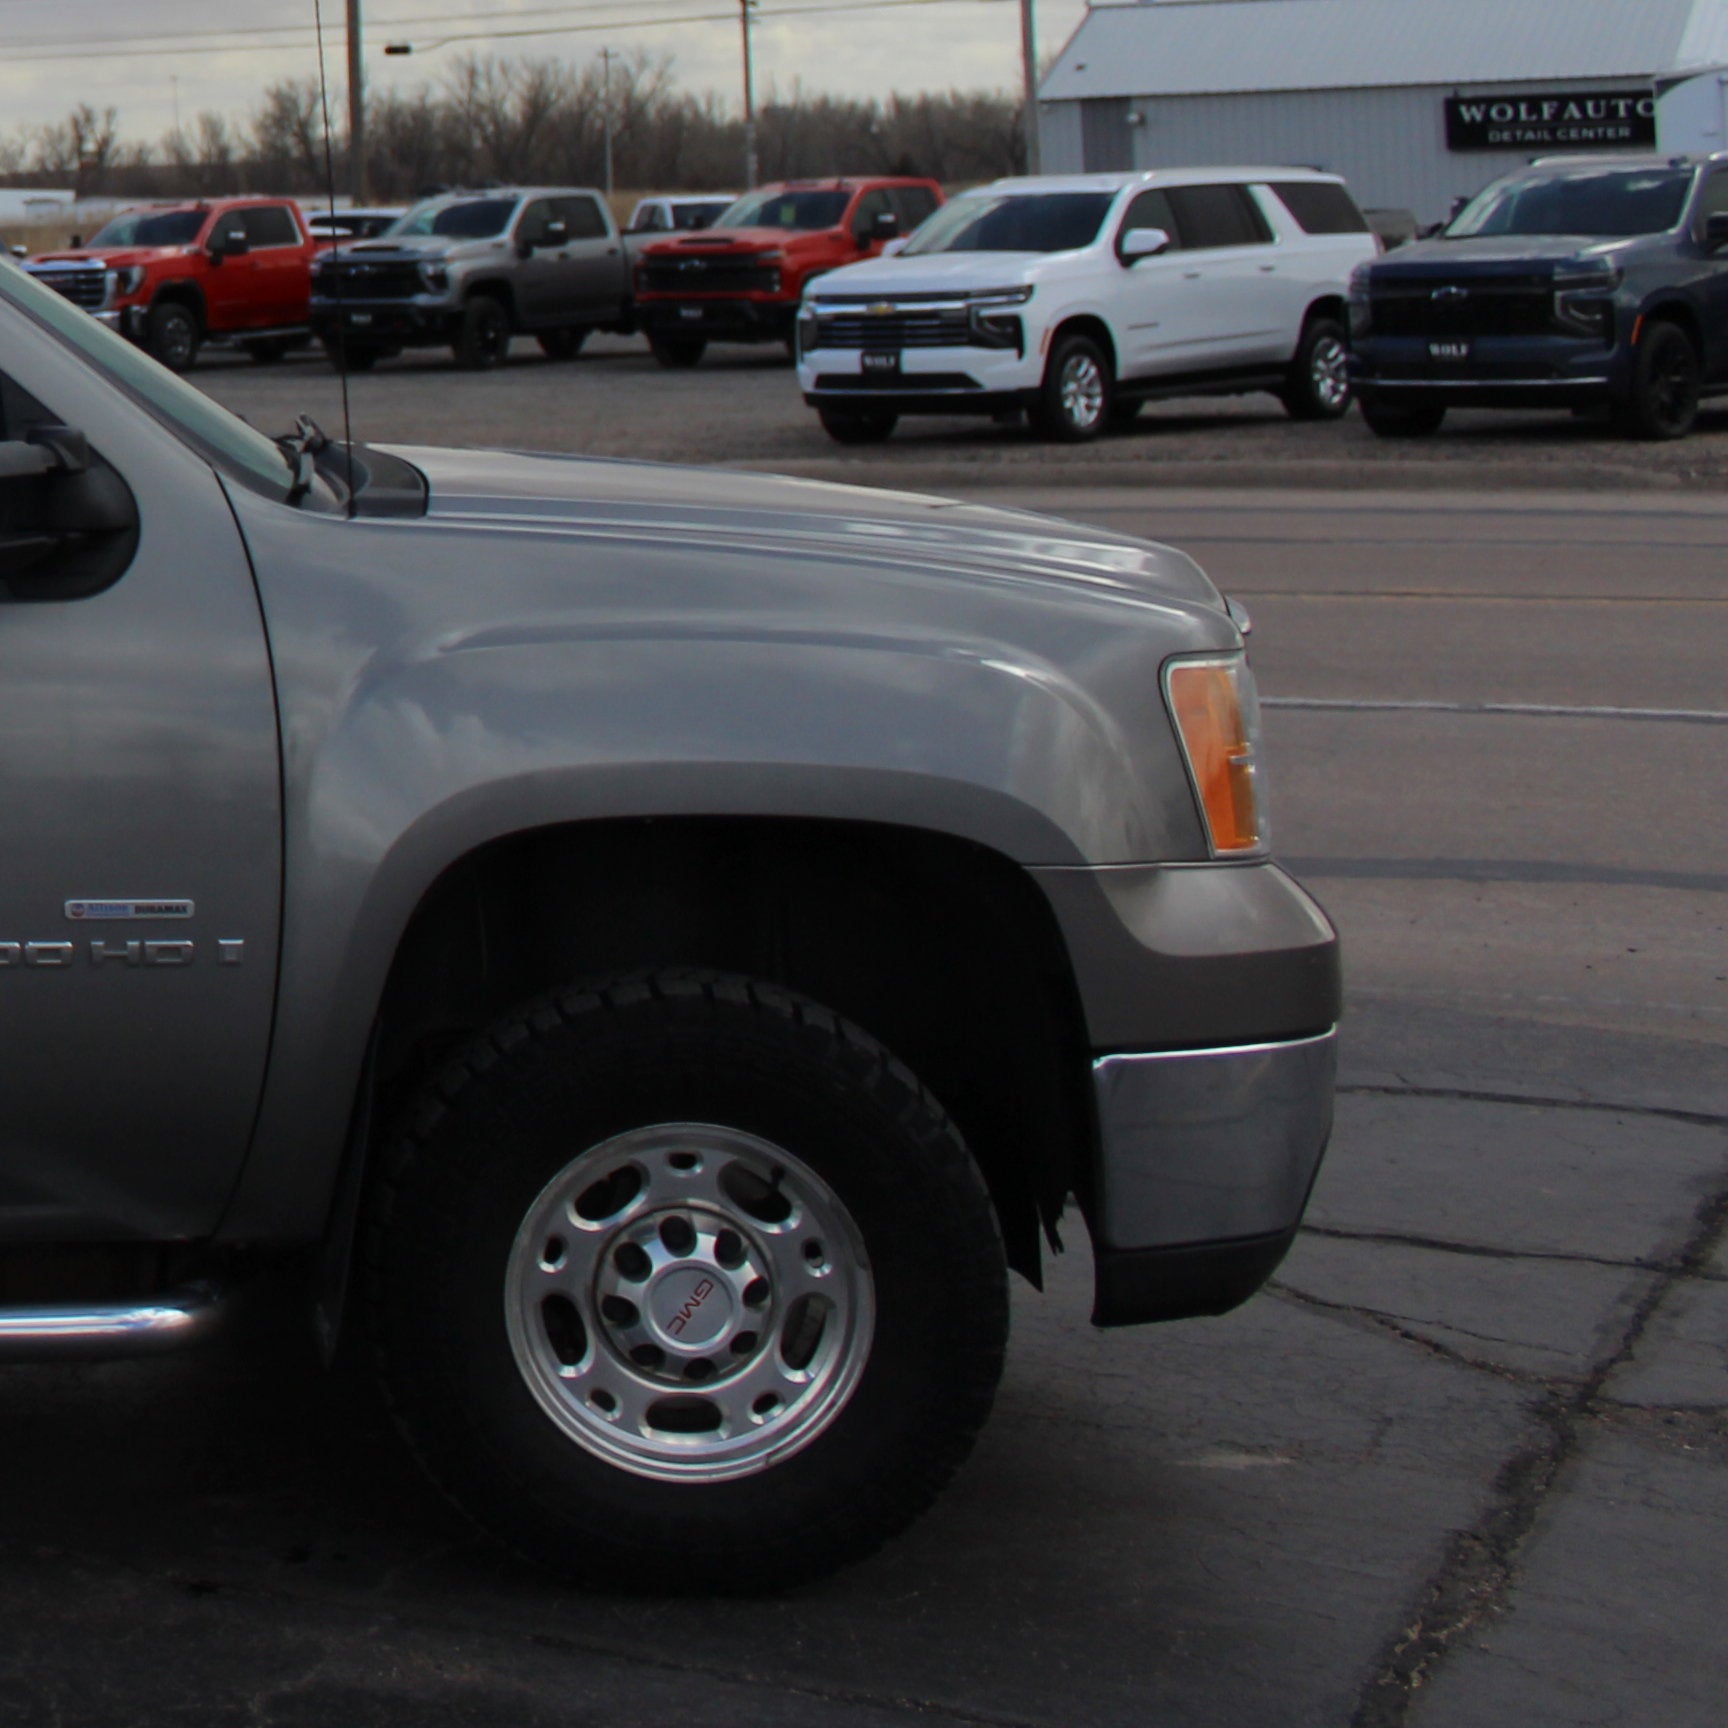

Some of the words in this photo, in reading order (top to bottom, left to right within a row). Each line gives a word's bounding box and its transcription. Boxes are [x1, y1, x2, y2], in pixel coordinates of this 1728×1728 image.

[1488, 129, 1548, 143] DETAIL
[1556, 126, 1631, 140] CENTER
[90, 940, 194, 966] HD
[666, 1278, 713, 1335] GMC
